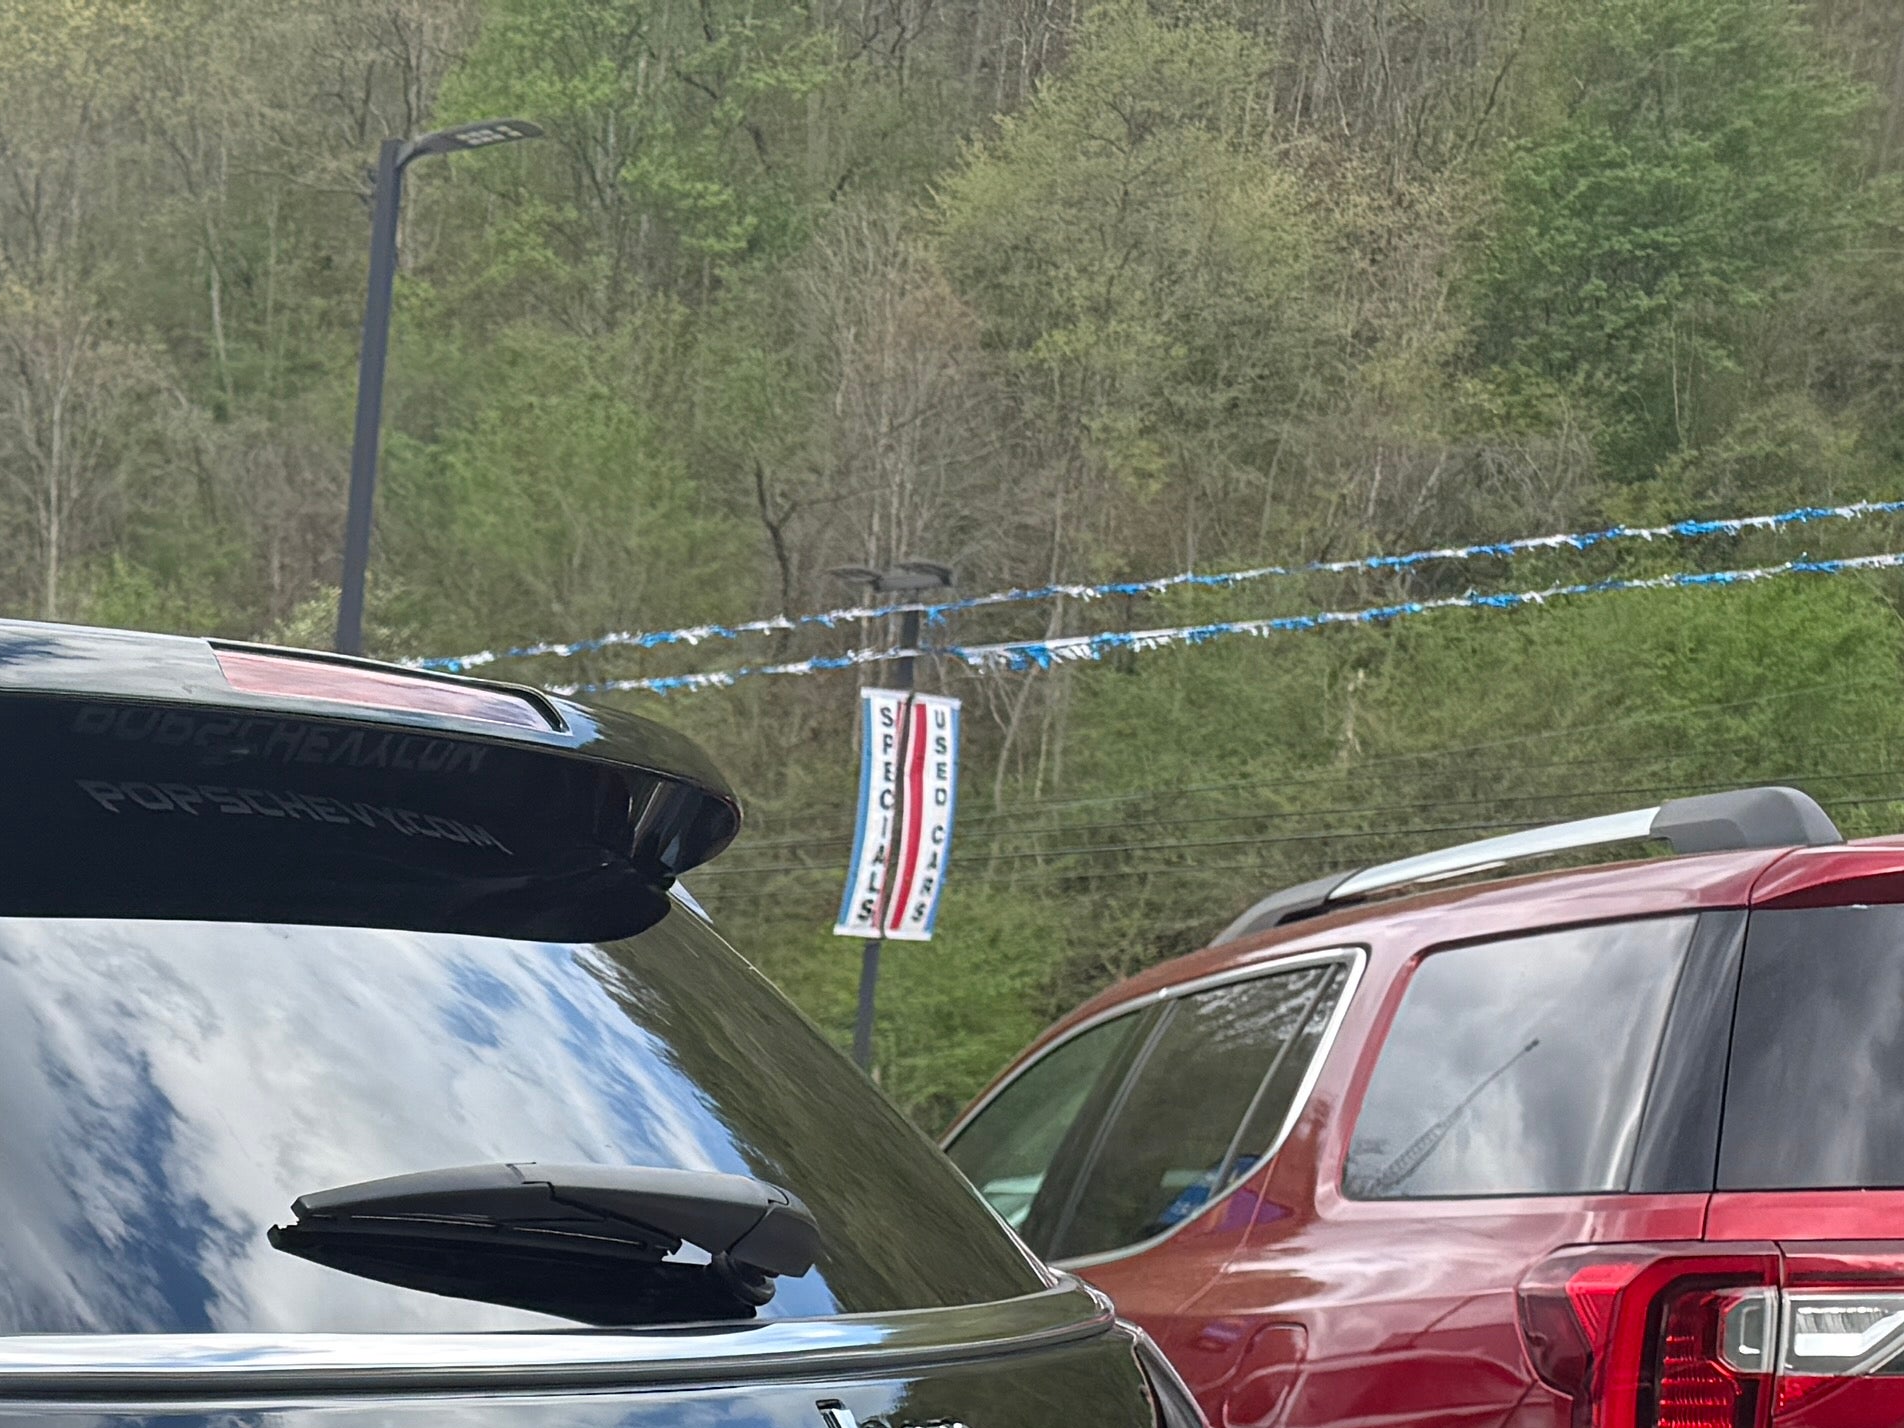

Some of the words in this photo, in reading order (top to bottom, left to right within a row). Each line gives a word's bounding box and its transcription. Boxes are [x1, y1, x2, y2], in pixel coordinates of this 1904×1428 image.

[934, 710, 949, 808] USED
[856, 707, 897, 923] SPECIALS
[911, 825, 946, 923] CARS
